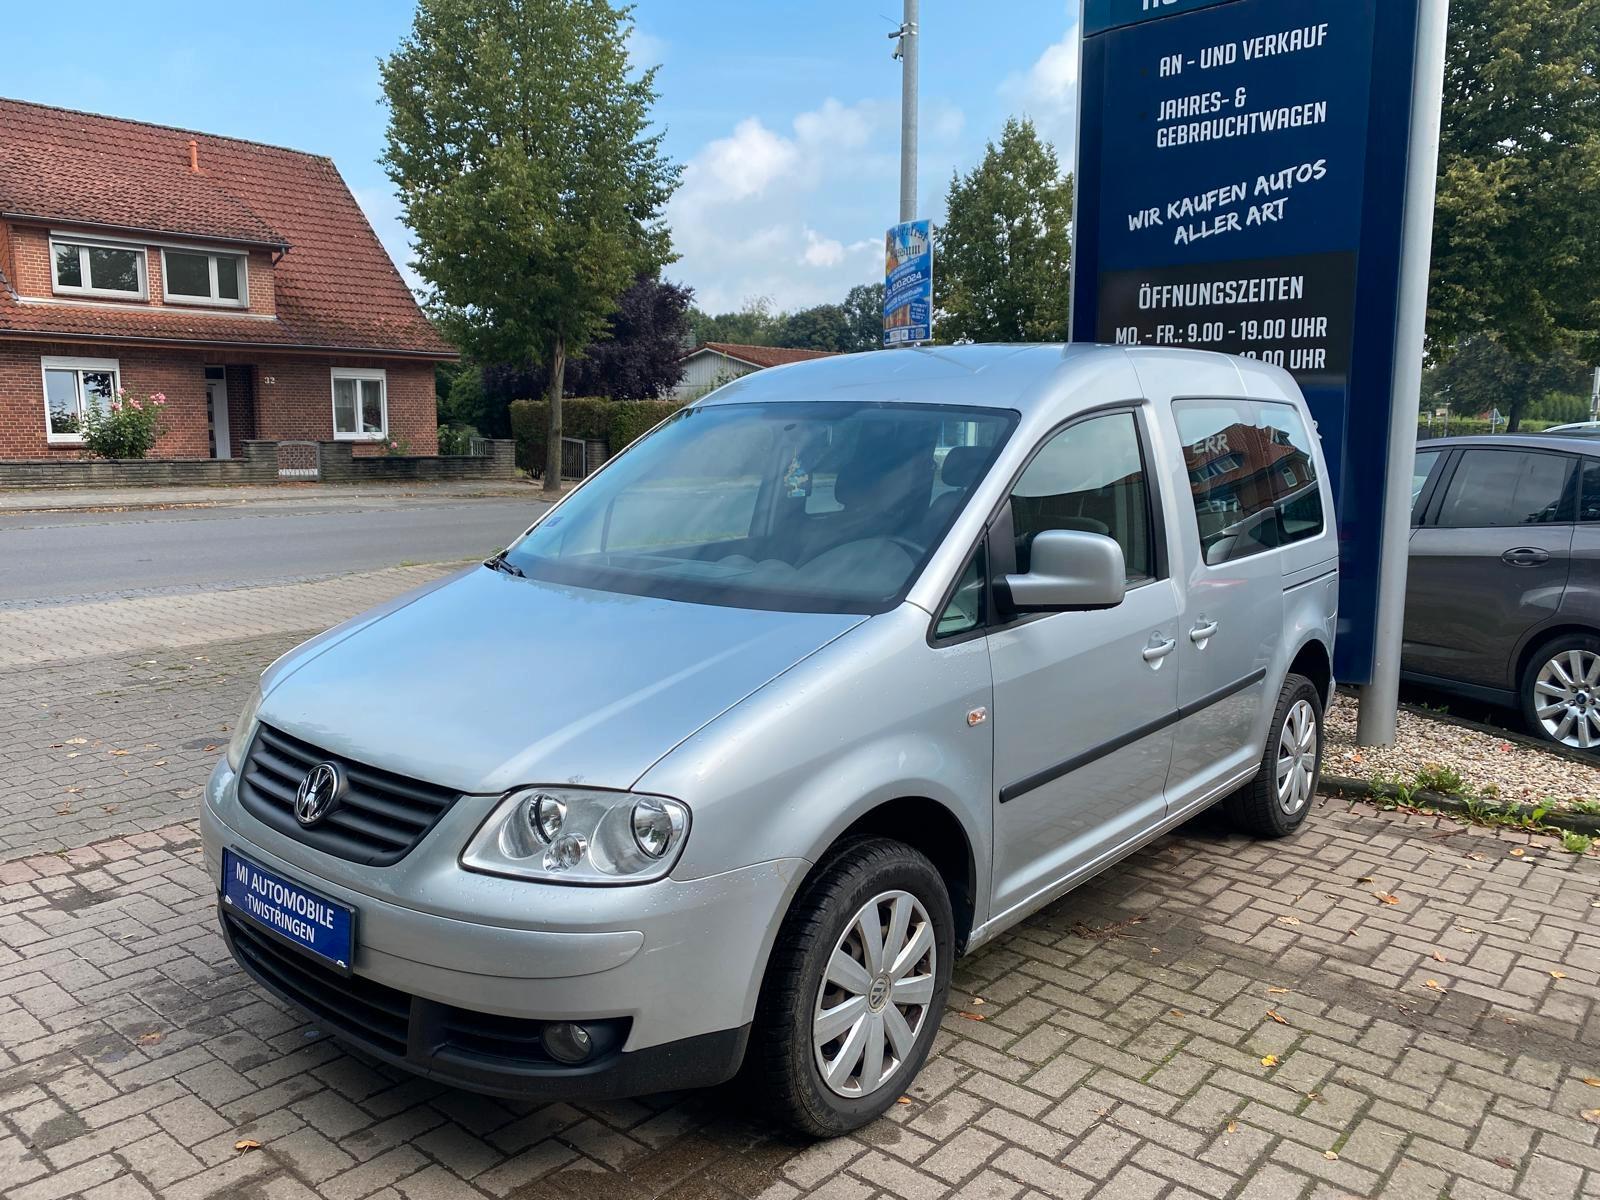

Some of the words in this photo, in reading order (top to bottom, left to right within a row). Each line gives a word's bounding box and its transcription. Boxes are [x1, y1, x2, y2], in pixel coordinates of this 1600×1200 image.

[1159, 53, 1182, 77] AN
[1200, 43, 1237, 69] UND
[1242, 23, 1329, 60] VERKAUF
[1156, 101, 1327, 148] GEBRAUCHTWAGEN
[1157, 91, 1230, 122] JAHRES-
[1234, 87, 1247, 108] &
[1128, 207, 1163, 231] WIR
[1167, 182, 1247, 220] KAUFEN
[1254, 159, 1327, 195] AUTOS
[1174, 213, 1242, 245] ALLER
[1246, 197, 1289, 226] ART
[1138, 276, 1304, 310] ÖFFNUNGSZEITEN
[1115, 326, 1141, 345] MO.
[1156, 324, 1183, 344] FR.:
[1188, 322, 1224, 343] 9.00
[1241, 319, 1286, 341] 19.00
[1291, 317, 1328, 338] UHR
[264, 376, 276, 384] 32
[1289, 349, 1326, 370] UHR
[236, 862, 248, 885] MI
[251, 872, 334, 930] AUTOMOBILE
[247, 893, 315, 943] TWISTRINGEN
